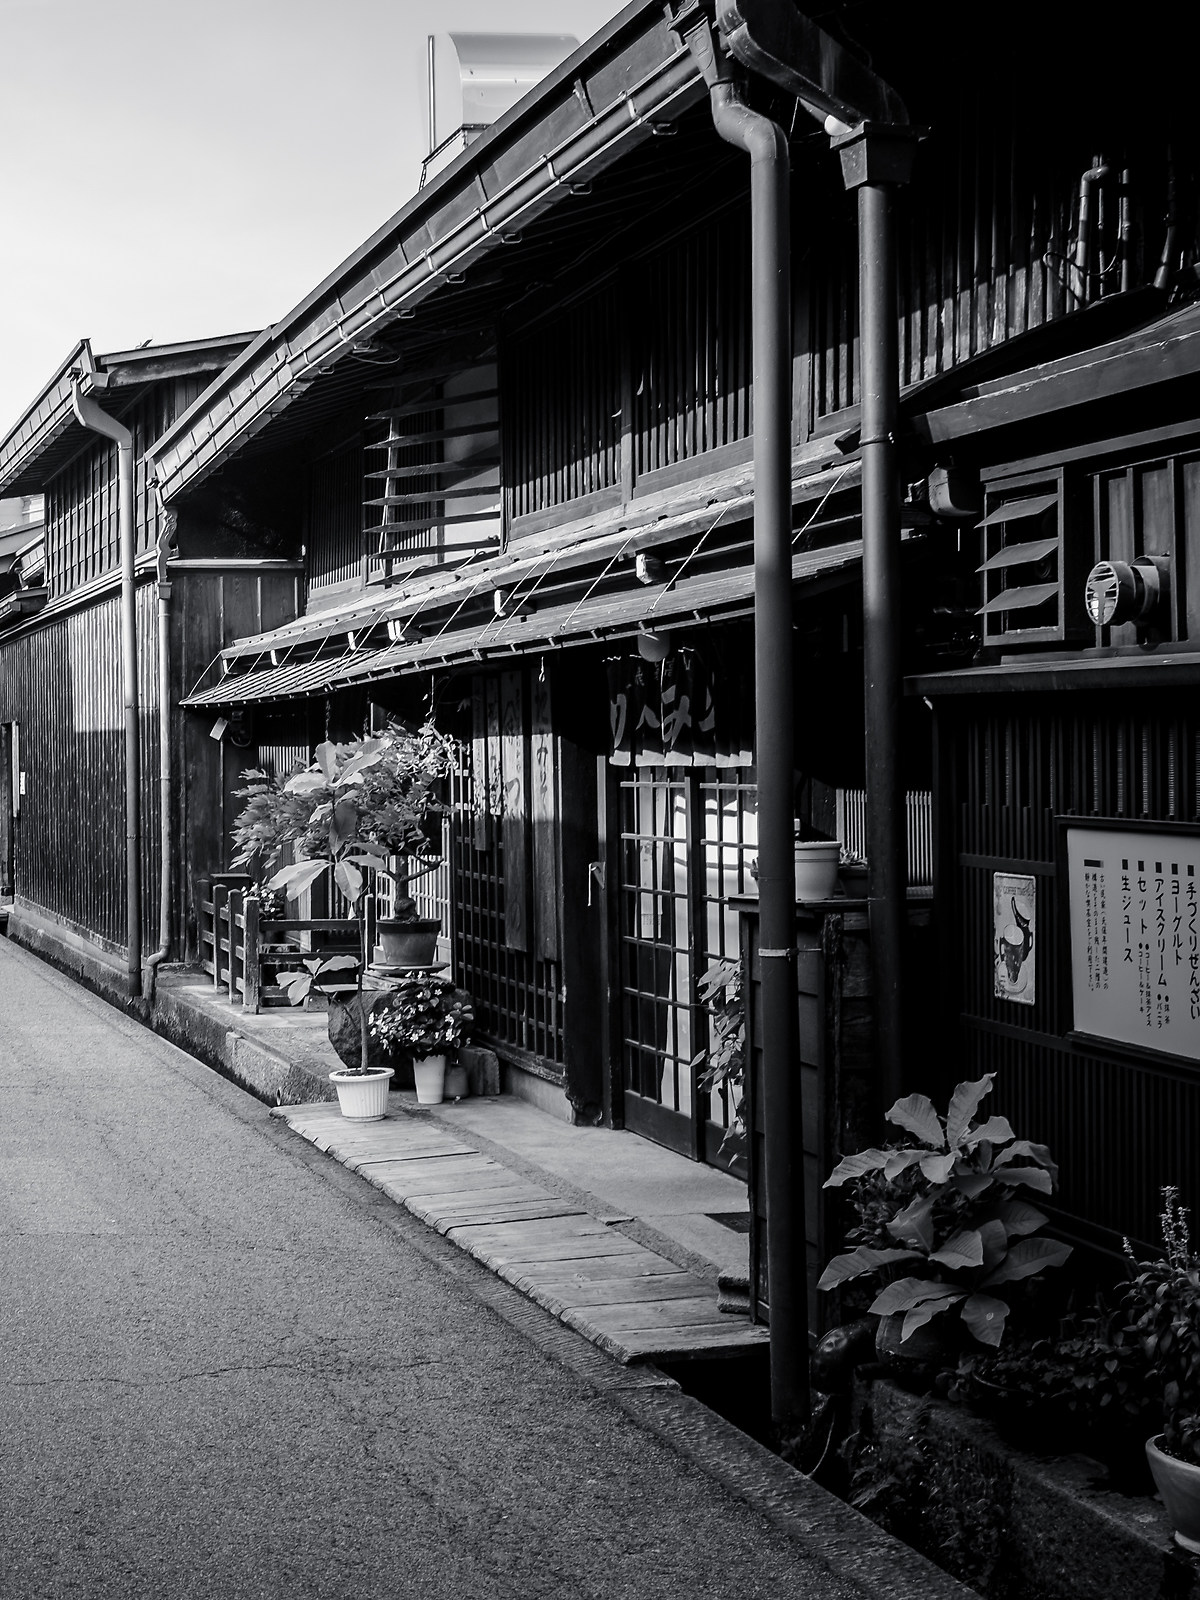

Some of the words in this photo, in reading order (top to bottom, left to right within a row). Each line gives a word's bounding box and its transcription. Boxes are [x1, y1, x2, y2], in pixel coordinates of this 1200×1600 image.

[1121, 875, 1133, 963] 生ジュース
[1138, 877, 1148, 935] セット
[1155, 878, 1168, 987] アイスクリーム
[1171, 880, 1183, 966] ヨーグルト
[1186, 881, 1200, 1020] 手づくりぜんざい
